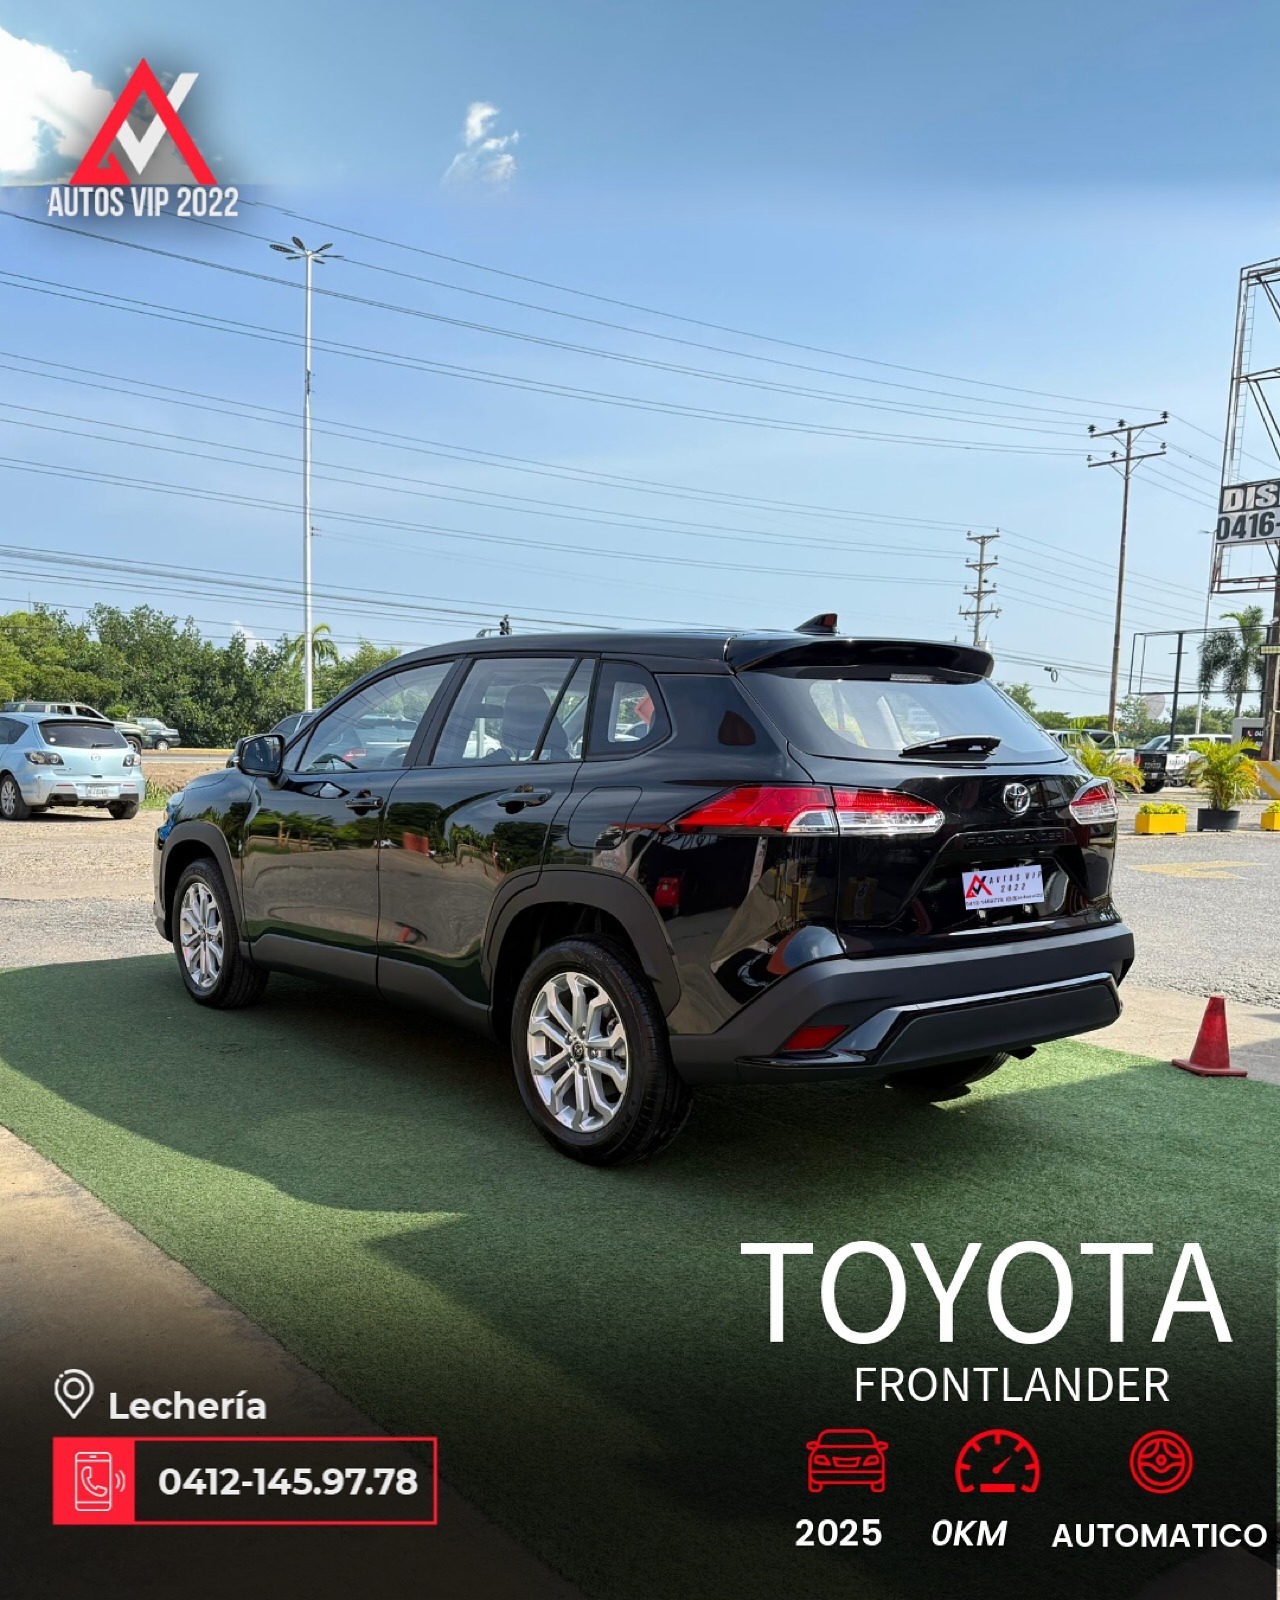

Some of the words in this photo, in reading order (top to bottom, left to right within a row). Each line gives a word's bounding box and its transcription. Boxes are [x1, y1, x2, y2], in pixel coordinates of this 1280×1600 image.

[1222, 484, 1280, 511] DIS
[989, 873, 1020, 885] AUTOS
[1001, 882, 1026, 893] 2022
